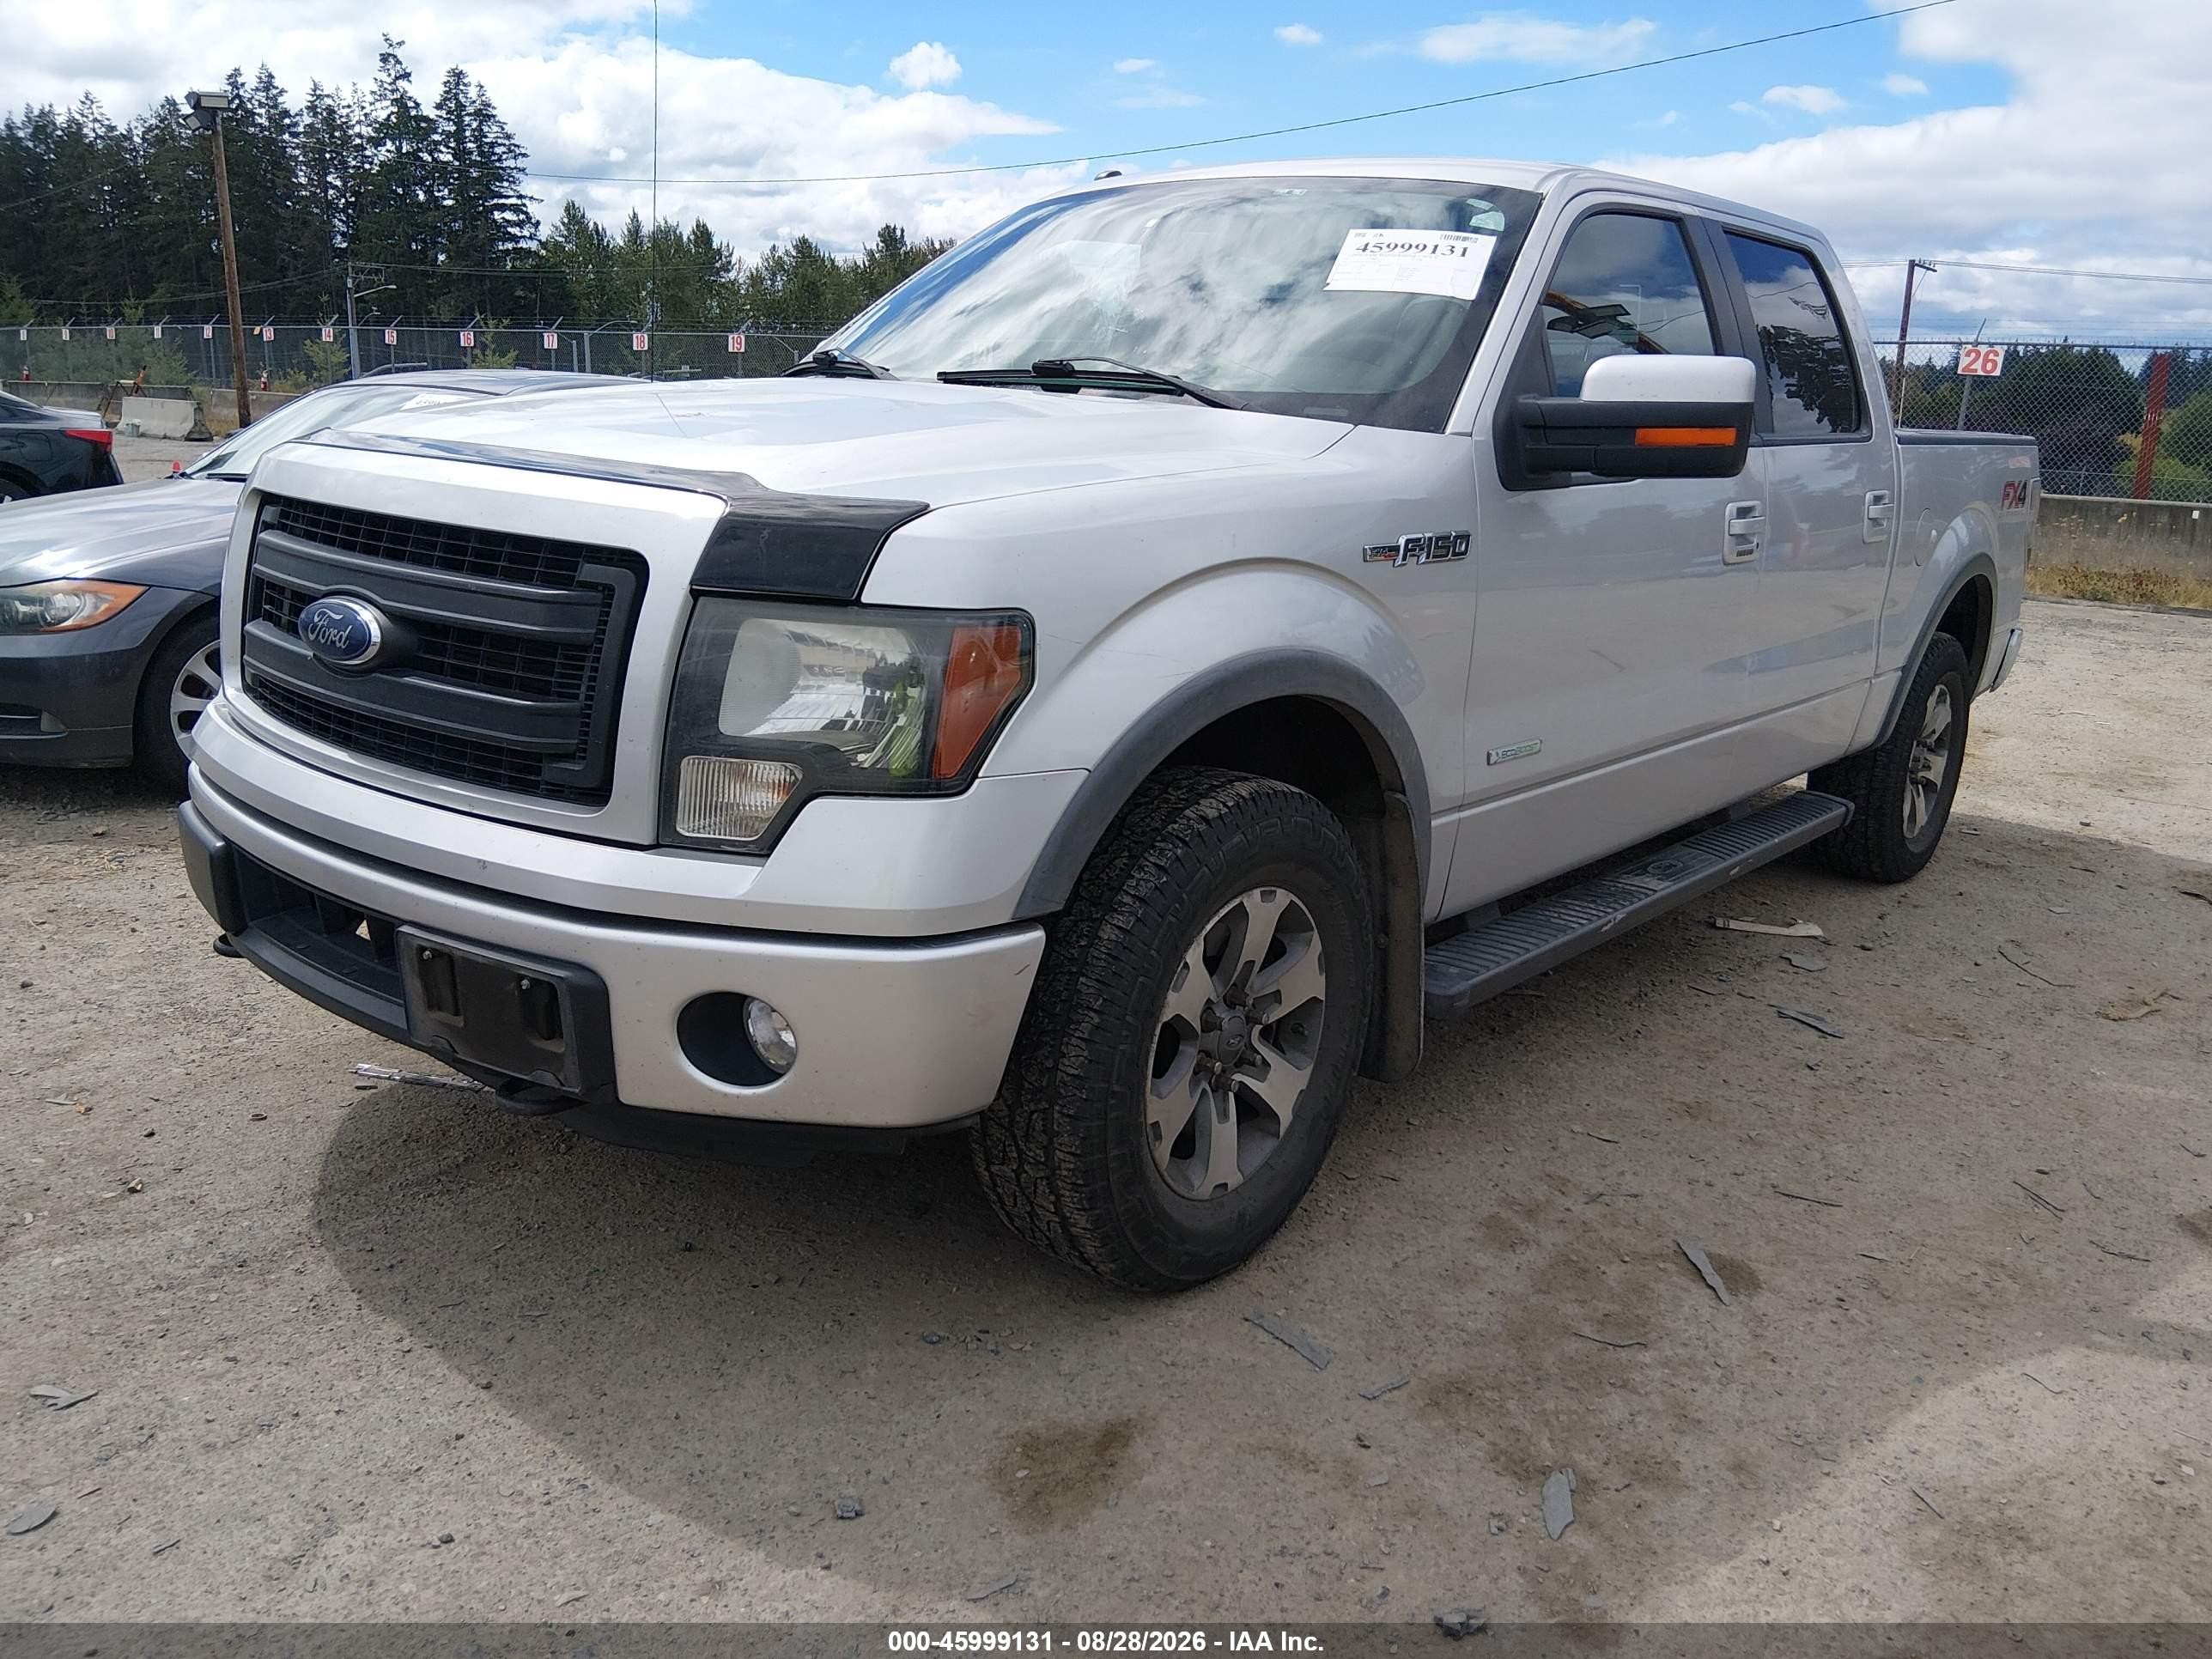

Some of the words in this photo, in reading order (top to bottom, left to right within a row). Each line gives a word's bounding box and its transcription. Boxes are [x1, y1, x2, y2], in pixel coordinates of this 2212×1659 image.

[1354, 240, 1469, 258] 45999131
[205, 326, 211, 337] 12
[264, 327, 272, 340] 13
[325, 328, 332, 340] 14
[386, 331, 395, 343] 15
[463, 332, 472, 345] 16
[546, 334, 555, 348] 17
[635, 335, 646, 349] 18
[731, 336, 743, 351] 19
[1961, 348, 2000, 374] 26
[2001, 480, 2028, 510] FX4
[308, 608, 354, 649] Ford
